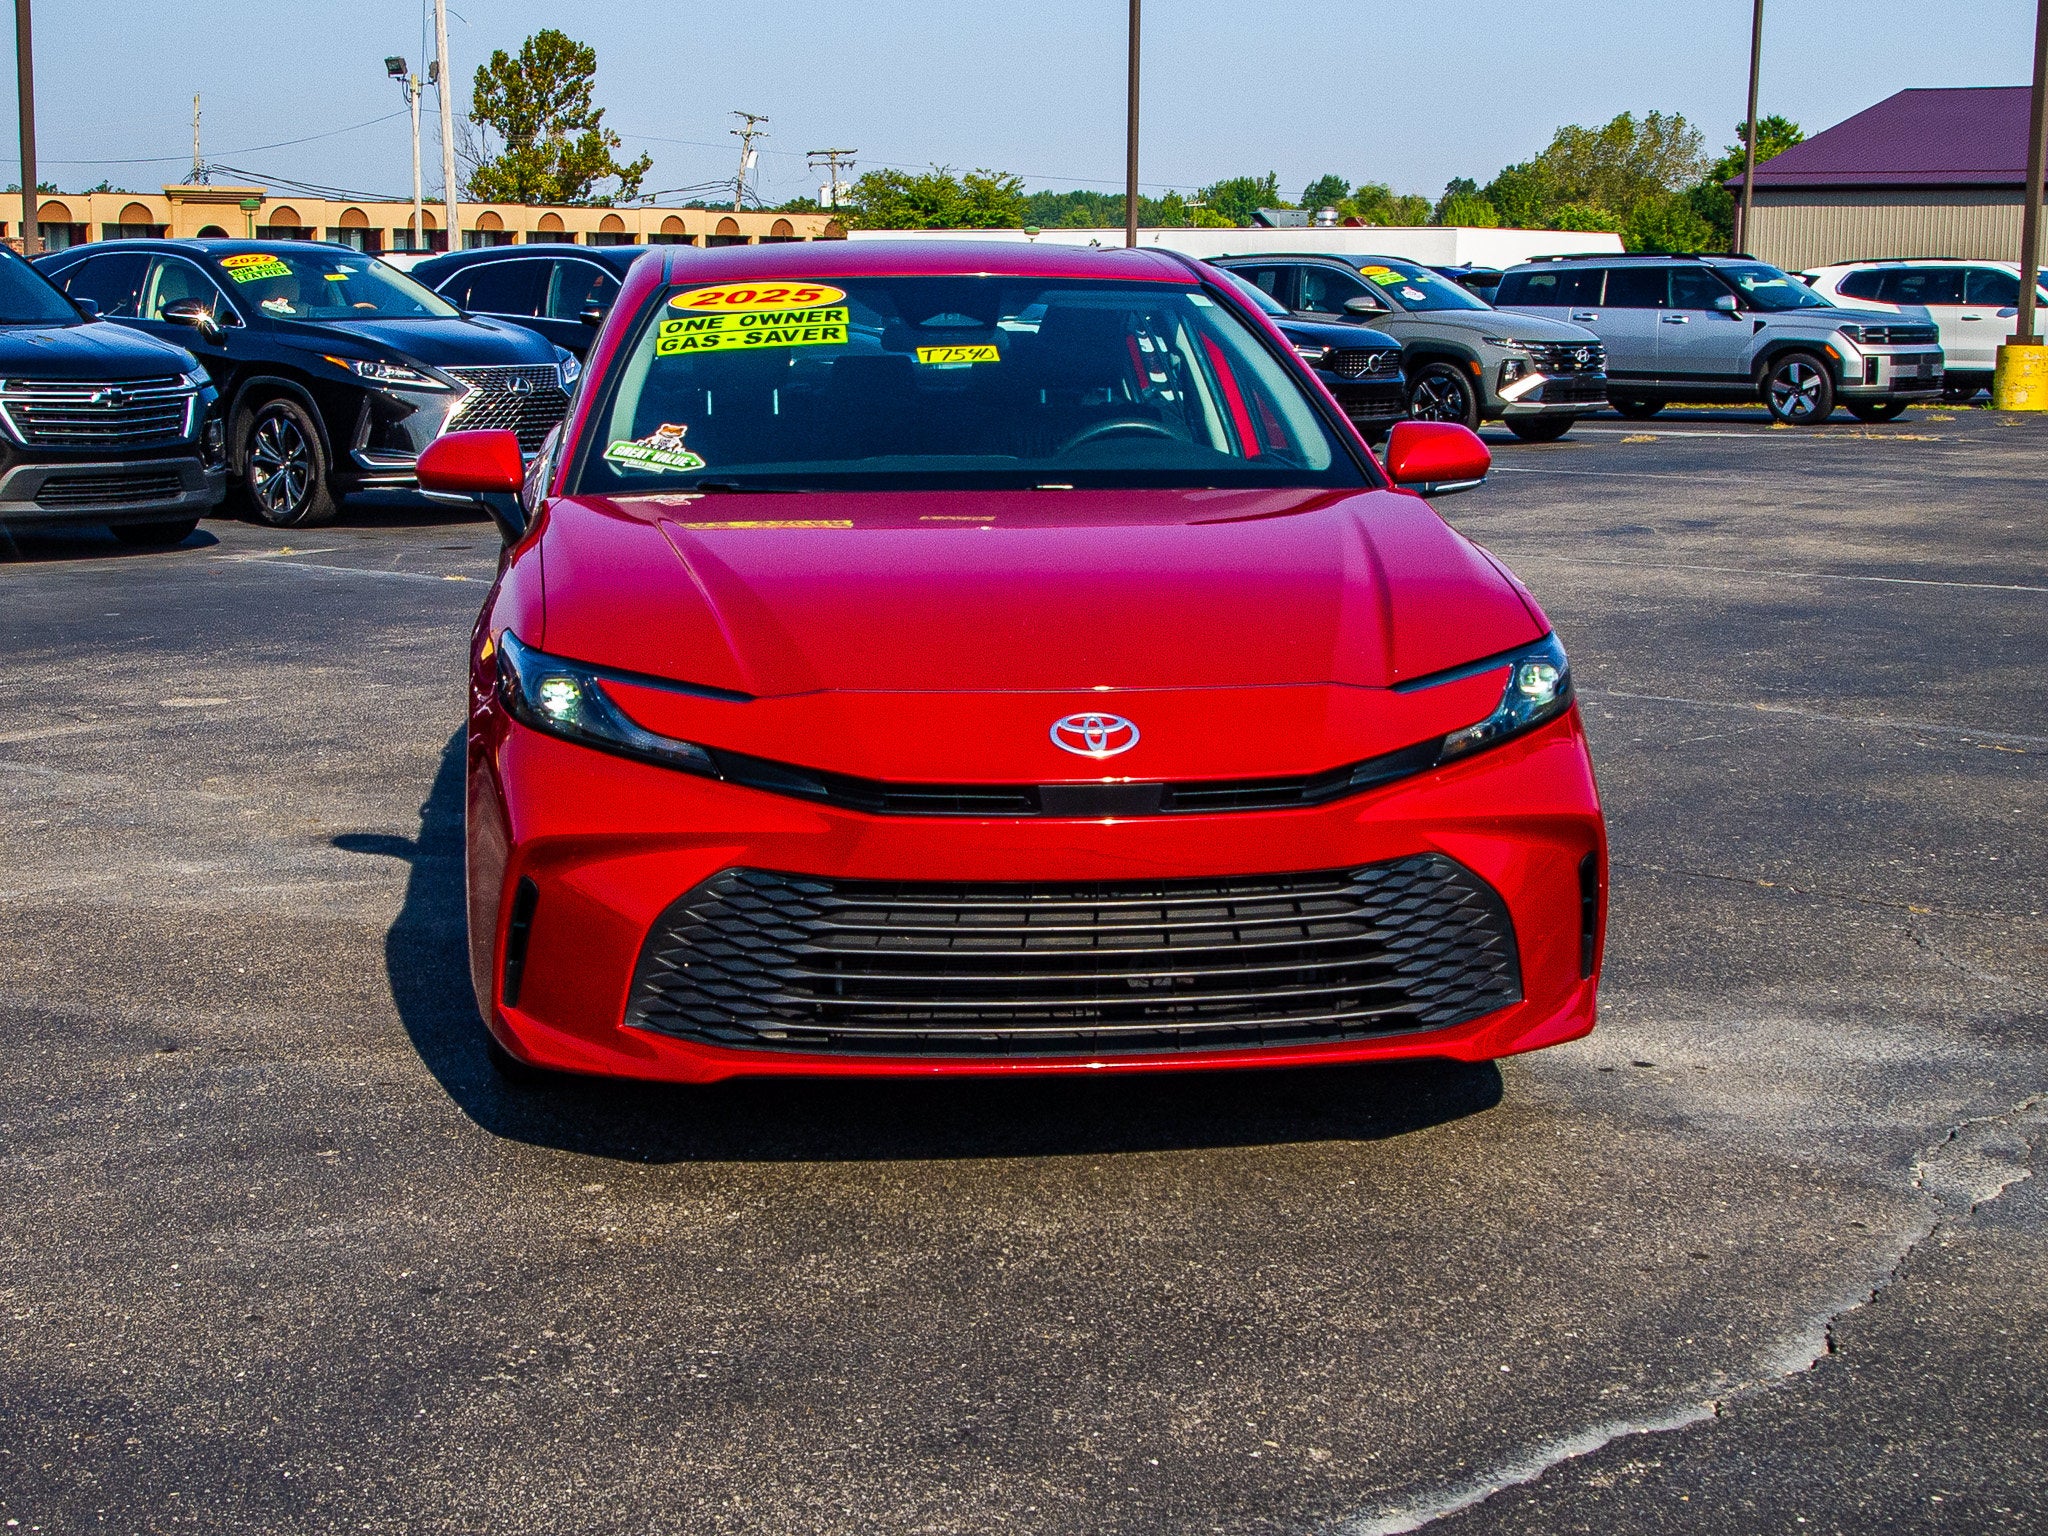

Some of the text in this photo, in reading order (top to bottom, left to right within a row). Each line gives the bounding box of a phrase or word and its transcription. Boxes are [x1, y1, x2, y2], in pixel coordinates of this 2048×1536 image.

[689, 288, 823, 307] 2025
[665, 310, 843, 333] ONE OWNER
[612, 446, 653, 460] GREAT
[651, 451, 691, 466] VALUE
